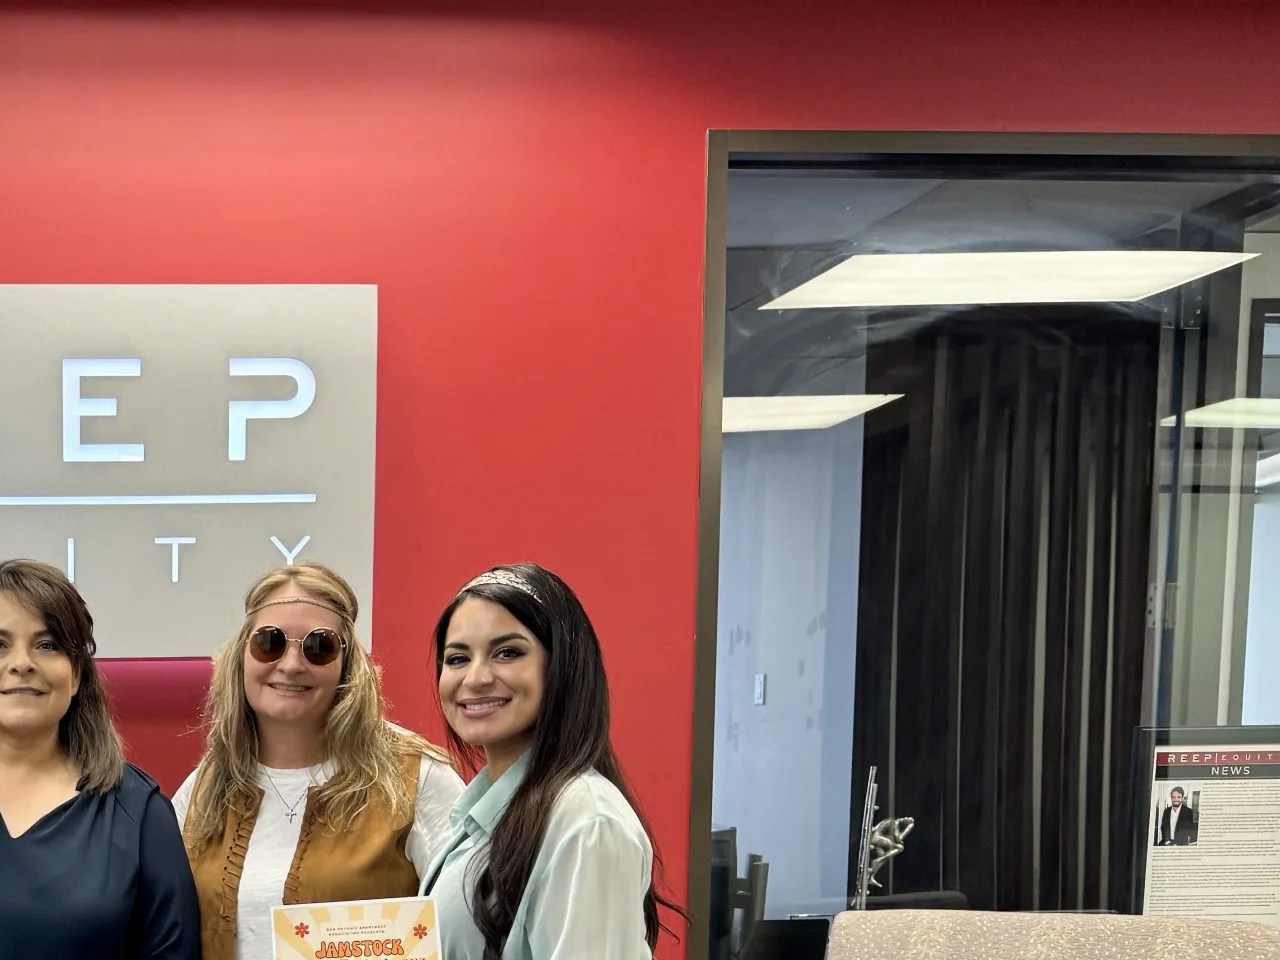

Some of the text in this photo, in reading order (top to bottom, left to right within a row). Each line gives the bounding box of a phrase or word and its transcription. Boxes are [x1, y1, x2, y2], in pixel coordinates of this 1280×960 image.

[1167, 753, 1274, 763] REEP EQUIT
[1211, 766, 1251, 776] NEWS
[315, 939, 405, 959] JAMSTOCK
